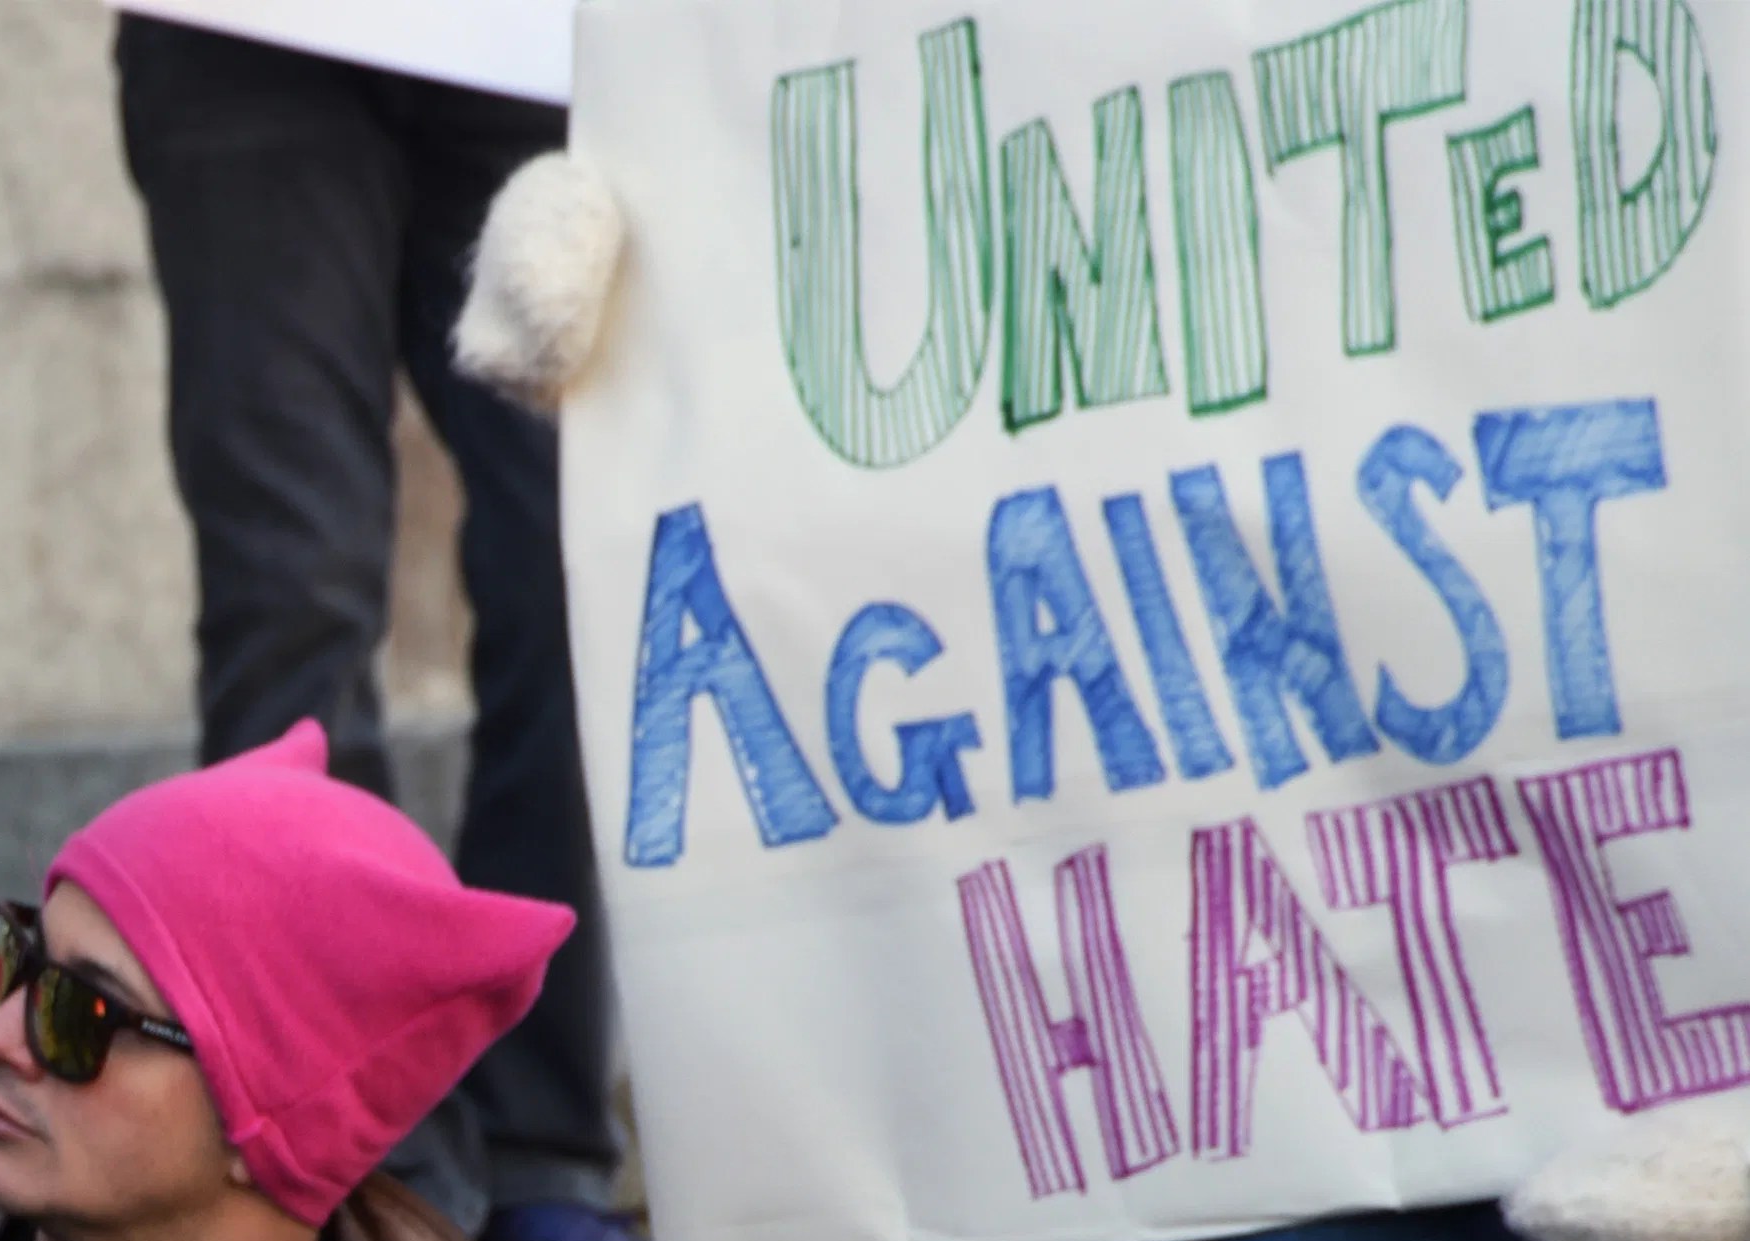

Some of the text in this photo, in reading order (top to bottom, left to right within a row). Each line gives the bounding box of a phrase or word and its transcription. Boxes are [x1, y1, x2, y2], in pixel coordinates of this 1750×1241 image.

[770, 0, 1718, 471] UNITED
[623, 395, 1667, 869] AGAINST
[956, 747, 1750, 1201] HATE
